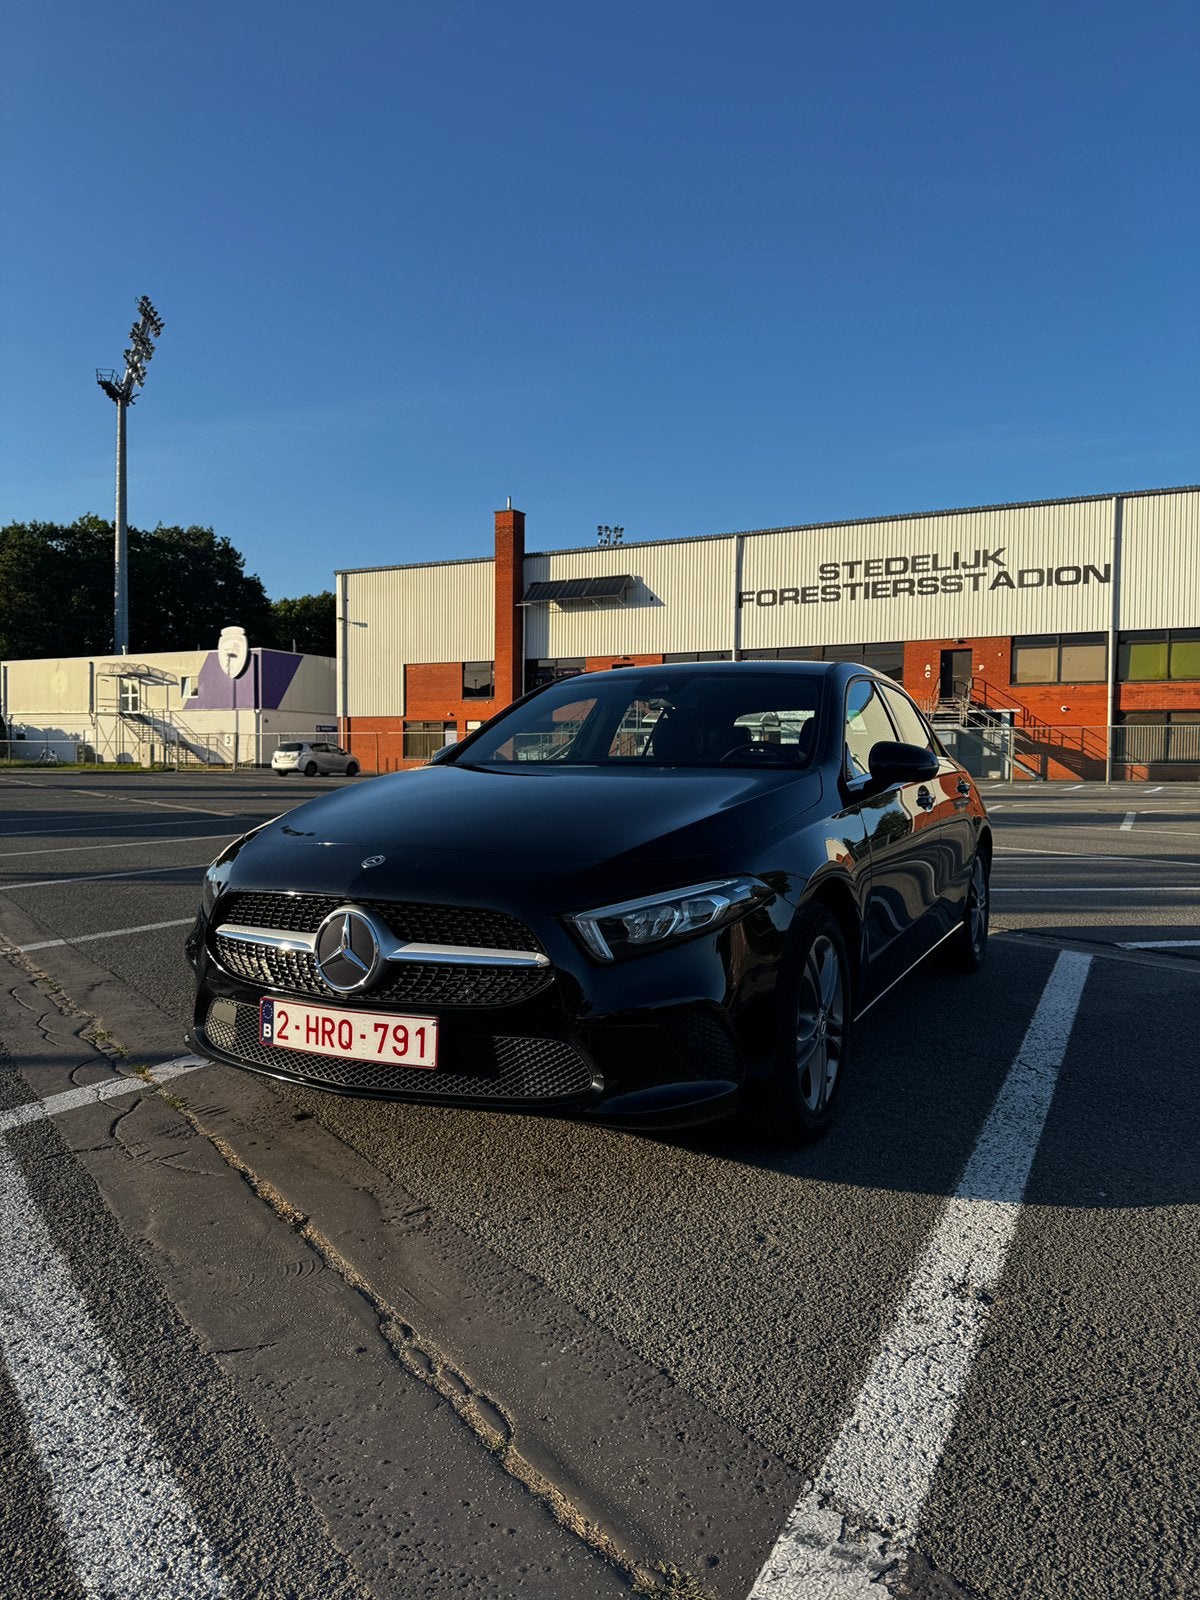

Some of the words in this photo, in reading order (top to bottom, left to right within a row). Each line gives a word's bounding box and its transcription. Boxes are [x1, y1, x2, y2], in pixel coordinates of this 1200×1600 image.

[819, 548, 1007, 581] STEDELIJK
[739, 563, 1112, 609] FORESTIERSSTADION
[226, 735, 232, 745] 3
[262, 1023, 272, 1038] B
[276, 1010, 426, 1058] 2-HRQ-791
